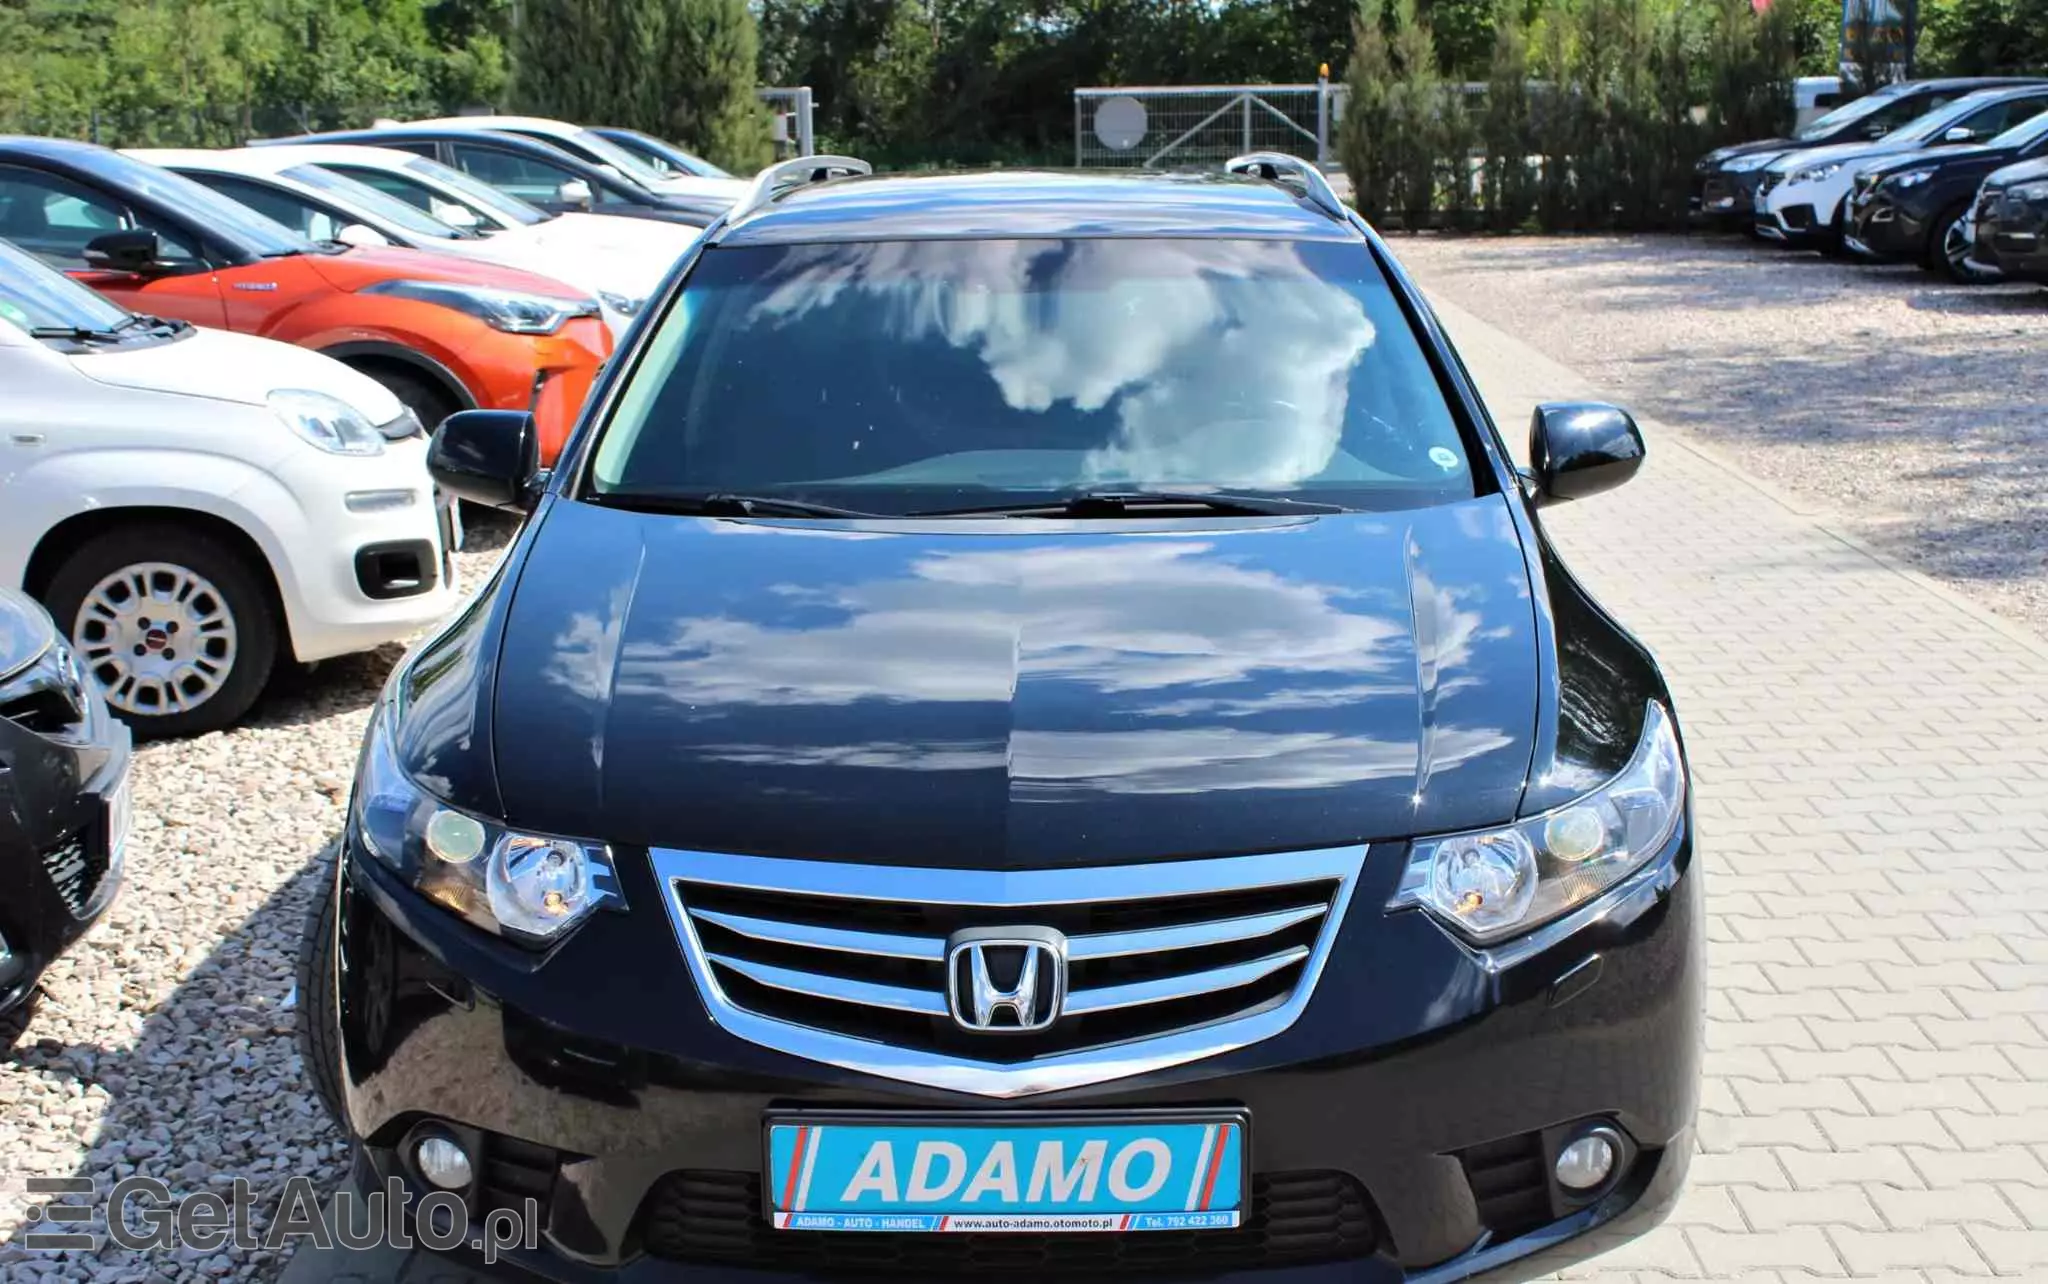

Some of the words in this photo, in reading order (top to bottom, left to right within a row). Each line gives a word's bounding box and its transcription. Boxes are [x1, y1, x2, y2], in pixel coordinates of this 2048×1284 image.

[841, 1138, 1172, 1202] ADAMO
[797, 1216, 834, 1227] ADAMO
[844, 1217, 872, 1228] AUTO
[881, 1218, 924, 1229] HANDEL
[954, 1218, 1113, 1229] www.auto-adamo.otomoto.pl
